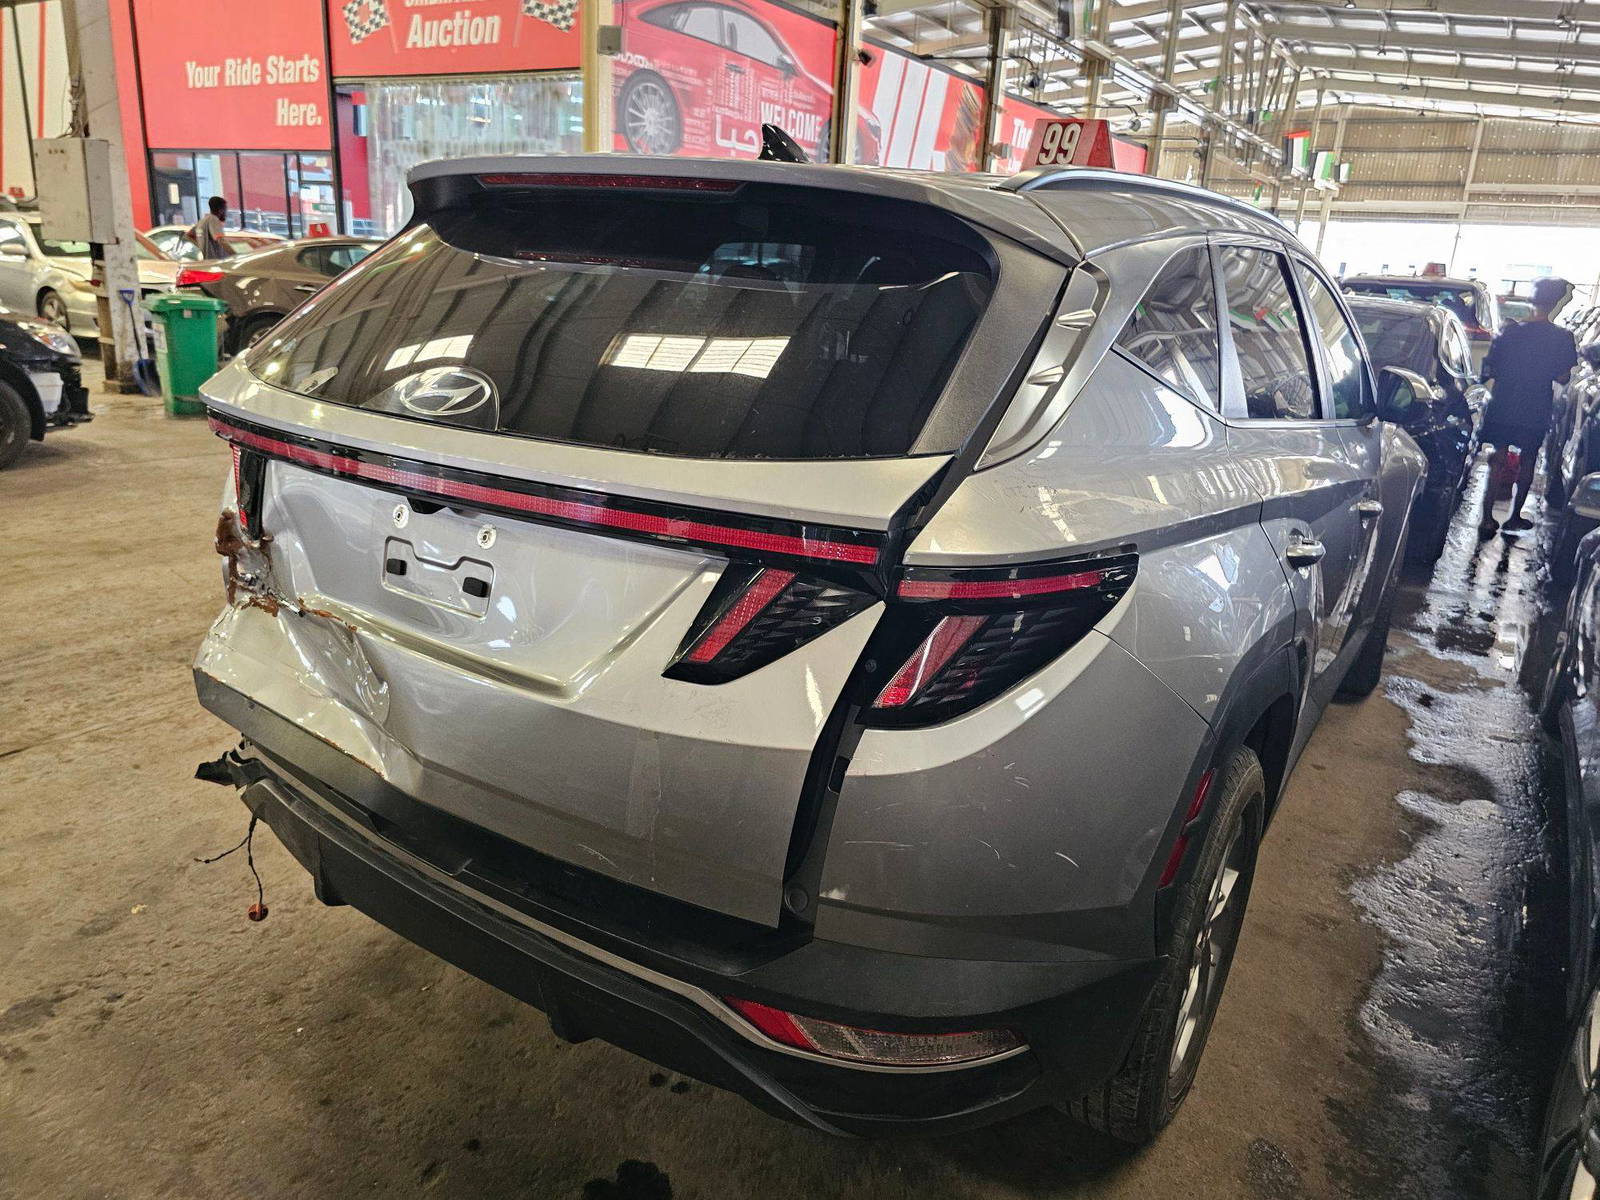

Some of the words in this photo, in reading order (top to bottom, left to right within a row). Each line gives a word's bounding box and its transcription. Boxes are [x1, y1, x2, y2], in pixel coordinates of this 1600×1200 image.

[406, 10, 501, 49] Auction
[186, 61, 220, 89] Your
[225, 57, 261, 87] Ride
[266, 53, 319, 84] Starts
[276, 98, 322, 126] Here.
[760, 101, 822, 142] WELCOME
[1038, 122, 1082, 165] 99
